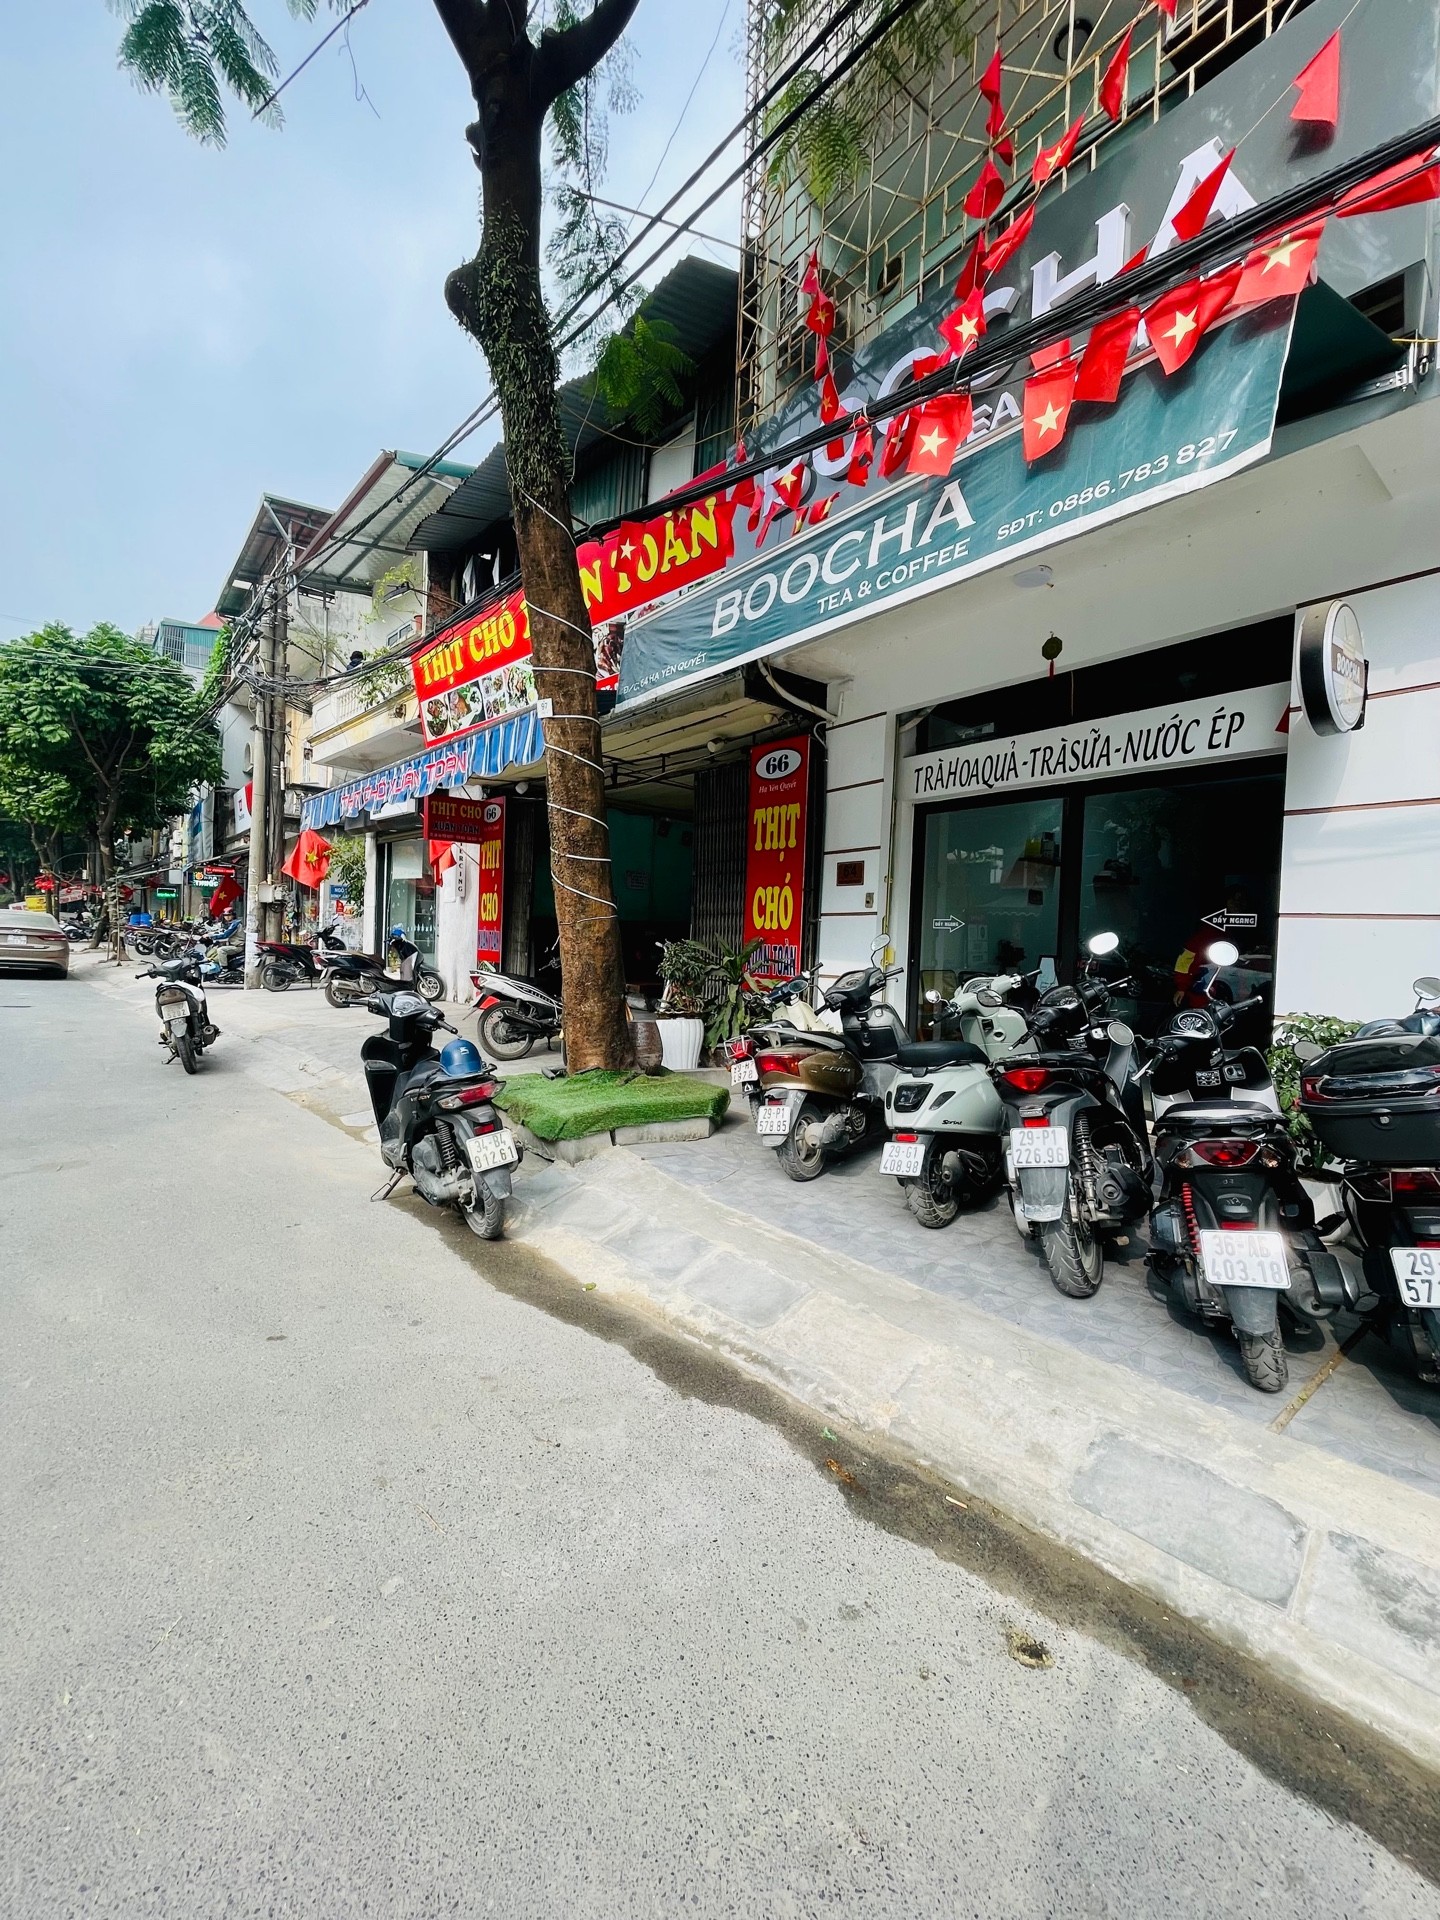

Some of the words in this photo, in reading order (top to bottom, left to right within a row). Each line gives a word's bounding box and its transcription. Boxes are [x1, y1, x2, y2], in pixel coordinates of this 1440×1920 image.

[997, 510, 1043, 541] SĐT:
[1049, 455, 1169, 518] 0886.783
[1175, 428, 1239, 465] 827
[710, 479, 976, 638] BOOCHA
[817, 591, 853, 614] TEA
[858, 581, 871, 598] &
[876, 537, 971, 590] COFFEE
[419, 637, 463, 686] THỊT
[469, 596, 515, 662] CHÓ
[1207, 706, 1245, 750] ÉP
[425, 750, 468, 782] TOÀN
[766, 753, 790, 775] 66
[430, 801, 457, 820] THỊT
[460, 802, 482, 820] CHÓ
[486, 807, 497, 820] 66
[753, 802, 800, 861] THỊT
[481, 840, 501, 878] THỊT
[481, 883, 499, 921] CHÓ
[752, 872, 794, 931] CHÓ
[759, 1120, 787, 1133] 578.85
[762, 1107, 785, 1120] 29-P1
[889, 1145, 918, 1159] 29-G1
[1019, 1129, 1057, 1147] 29-P1
[883, 1159, 919, 1174] 408.98
[1015, 1147, 1064, 1164] 226.96
[1211, 1258, 1284, 1284] 403.18
